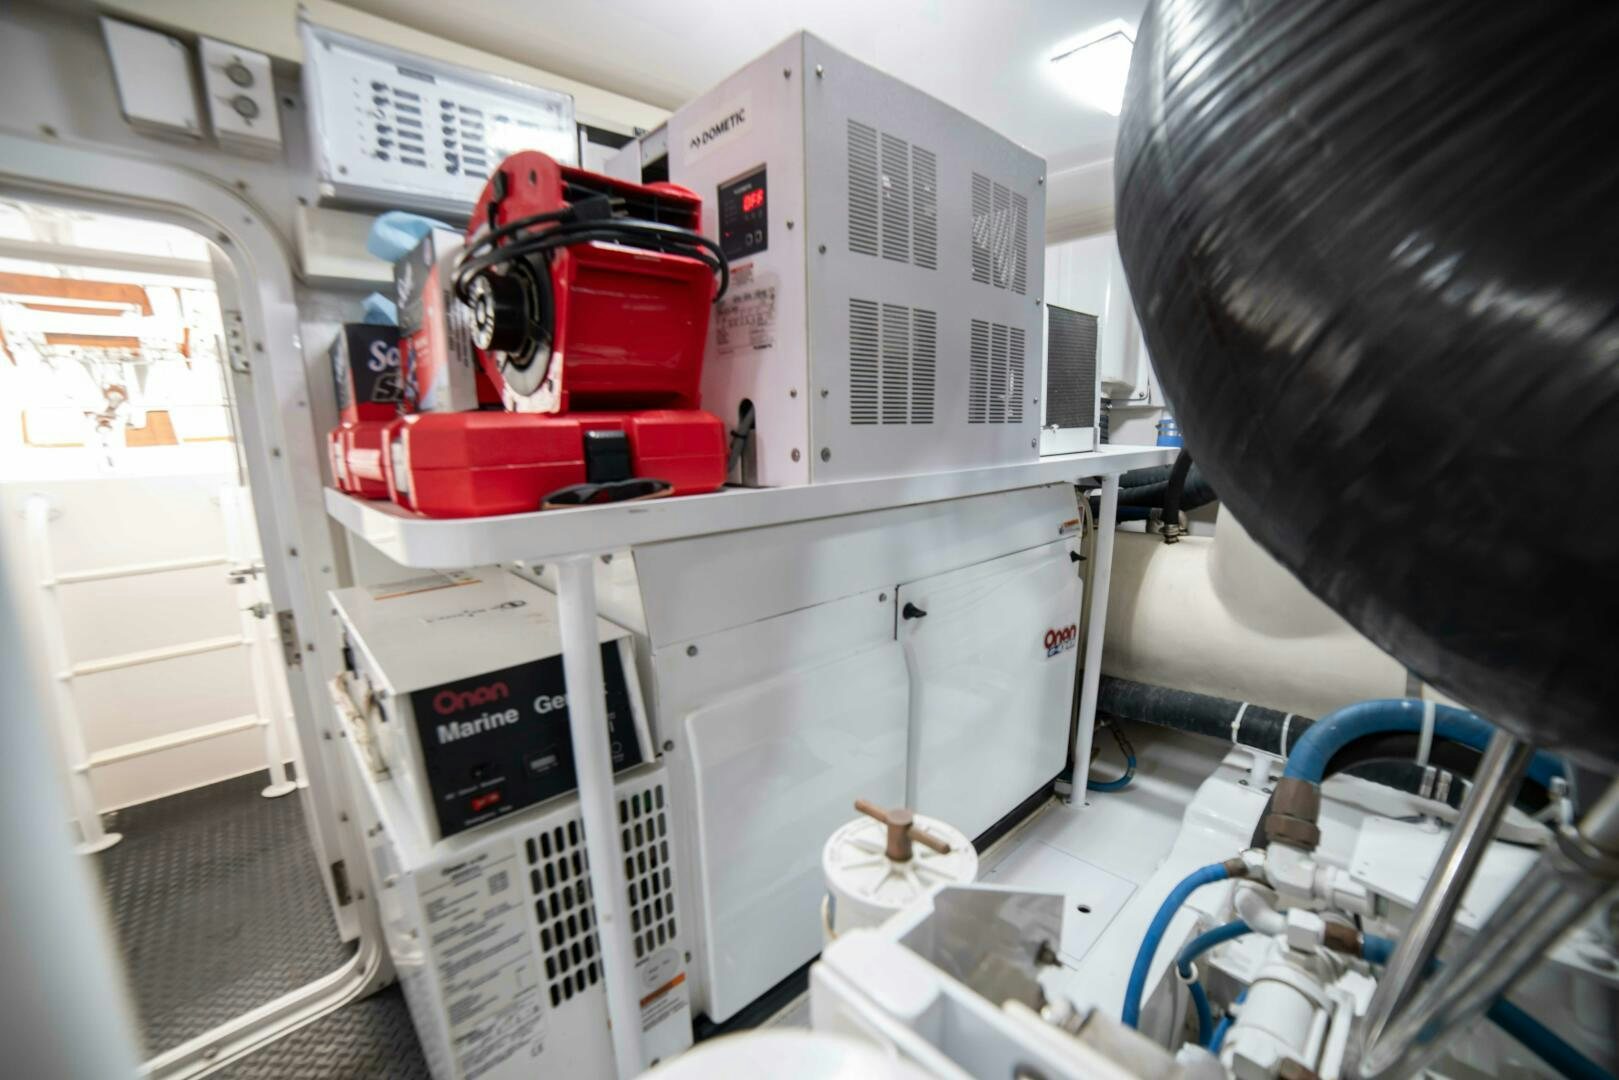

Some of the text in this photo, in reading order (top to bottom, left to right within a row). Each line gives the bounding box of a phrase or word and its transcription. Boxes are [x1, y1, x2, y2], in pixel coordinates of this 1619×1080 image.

[702, 108, 745, 144] DOMETIC
[1044, 624, 1077, 649] Onan
[432, 681, 510, 715] Onan
[437, 693, 570, 744] Marine Ge
